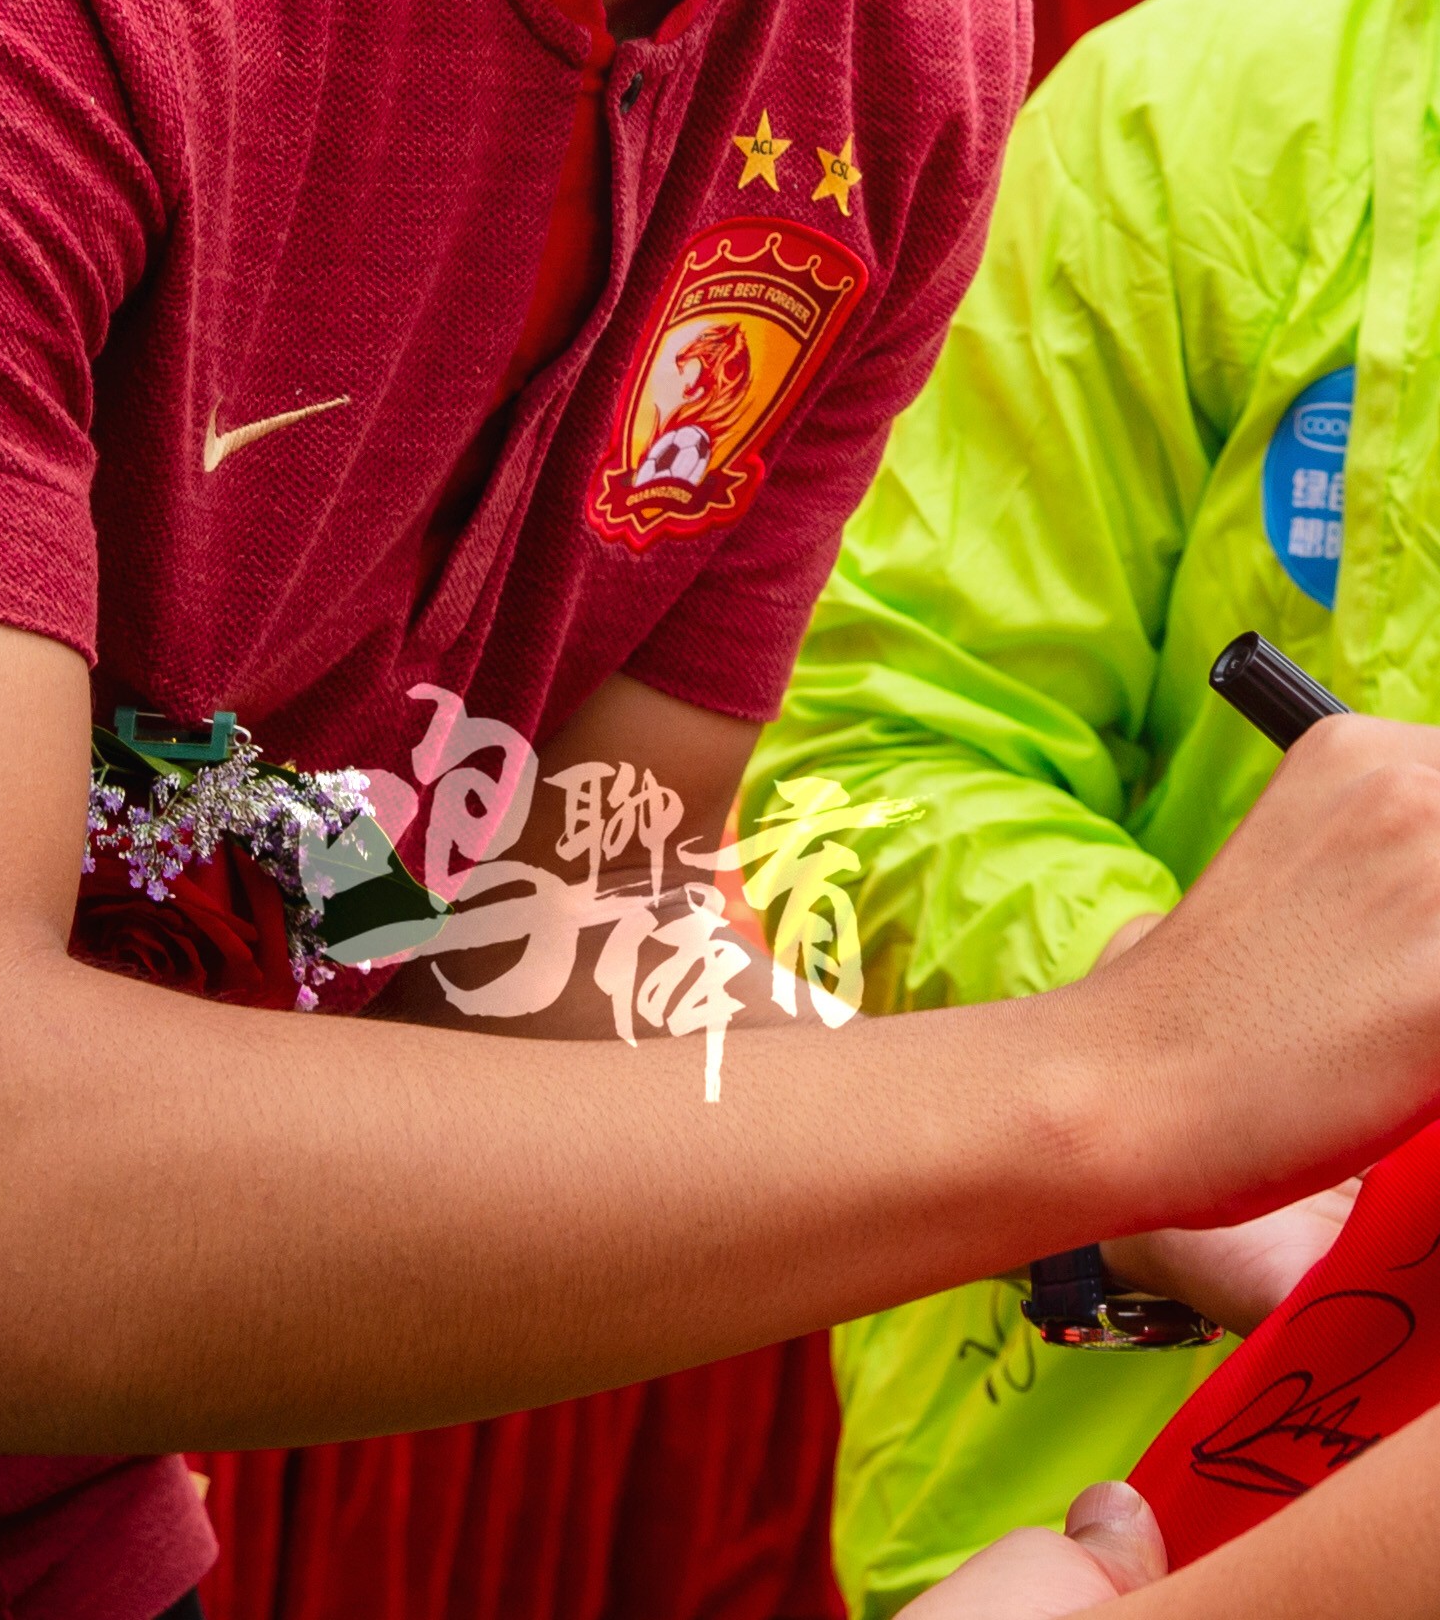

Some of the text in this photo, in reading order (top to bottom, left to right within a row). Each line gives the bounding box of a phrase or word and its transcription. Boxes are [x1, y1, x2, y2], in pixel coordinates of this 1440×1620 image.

[750, 138, 774, 156] ACL
[830, 158, 850, 181] CSL
[681, 282, 811, 325] BE THE BEST FOREVER
